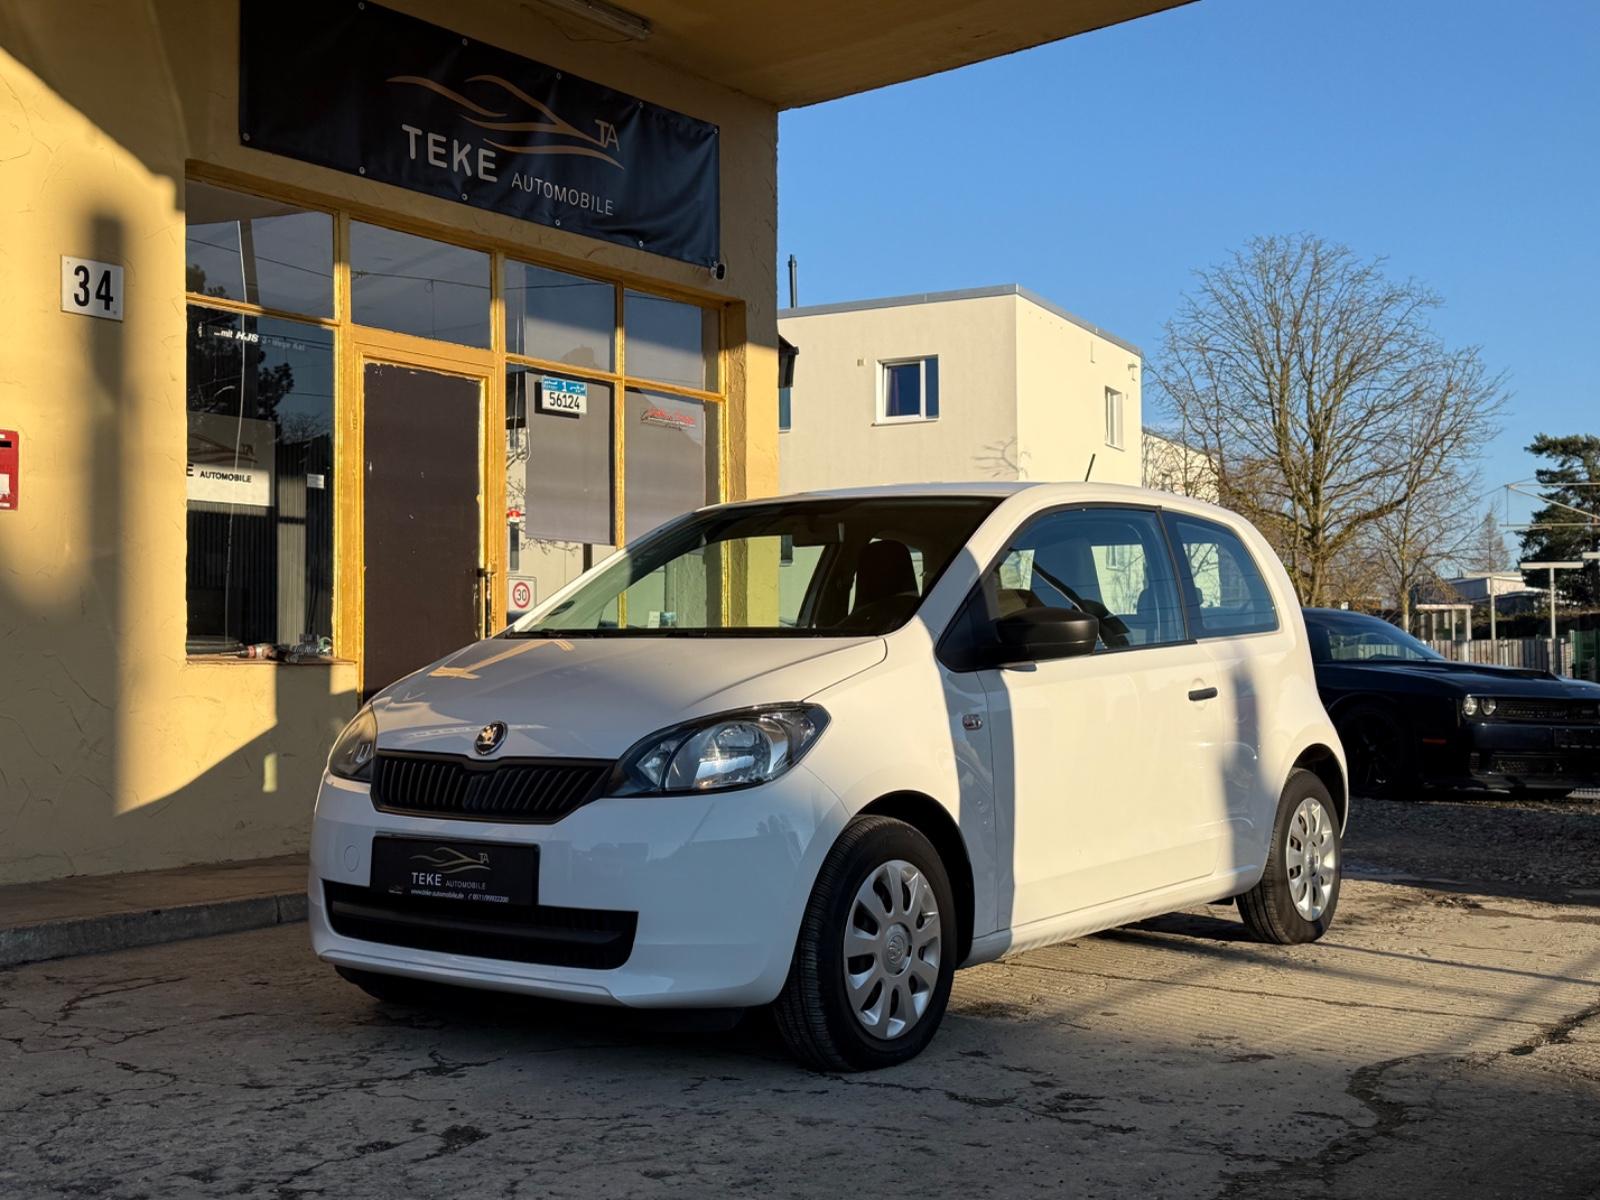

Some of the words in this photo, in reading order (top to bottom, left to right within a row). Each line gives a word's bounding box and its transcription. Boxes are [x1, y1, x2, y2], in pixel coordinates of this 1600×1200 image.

[594, 118, 621, 152] TA
[401, 123, 498, 183] TEKE
[511, 172, 615, 217] AUTOMOBILE
[73, 265, 114, 311] 34
[549, 391, 580, 410] 56124
[199, 470, 252, 483] AUTOMOBILE
[516, 589, 527, 602] 30
[411, 872, 443, 886] TEKE
[445, 880, 487, 890] AUTOMOBILE
